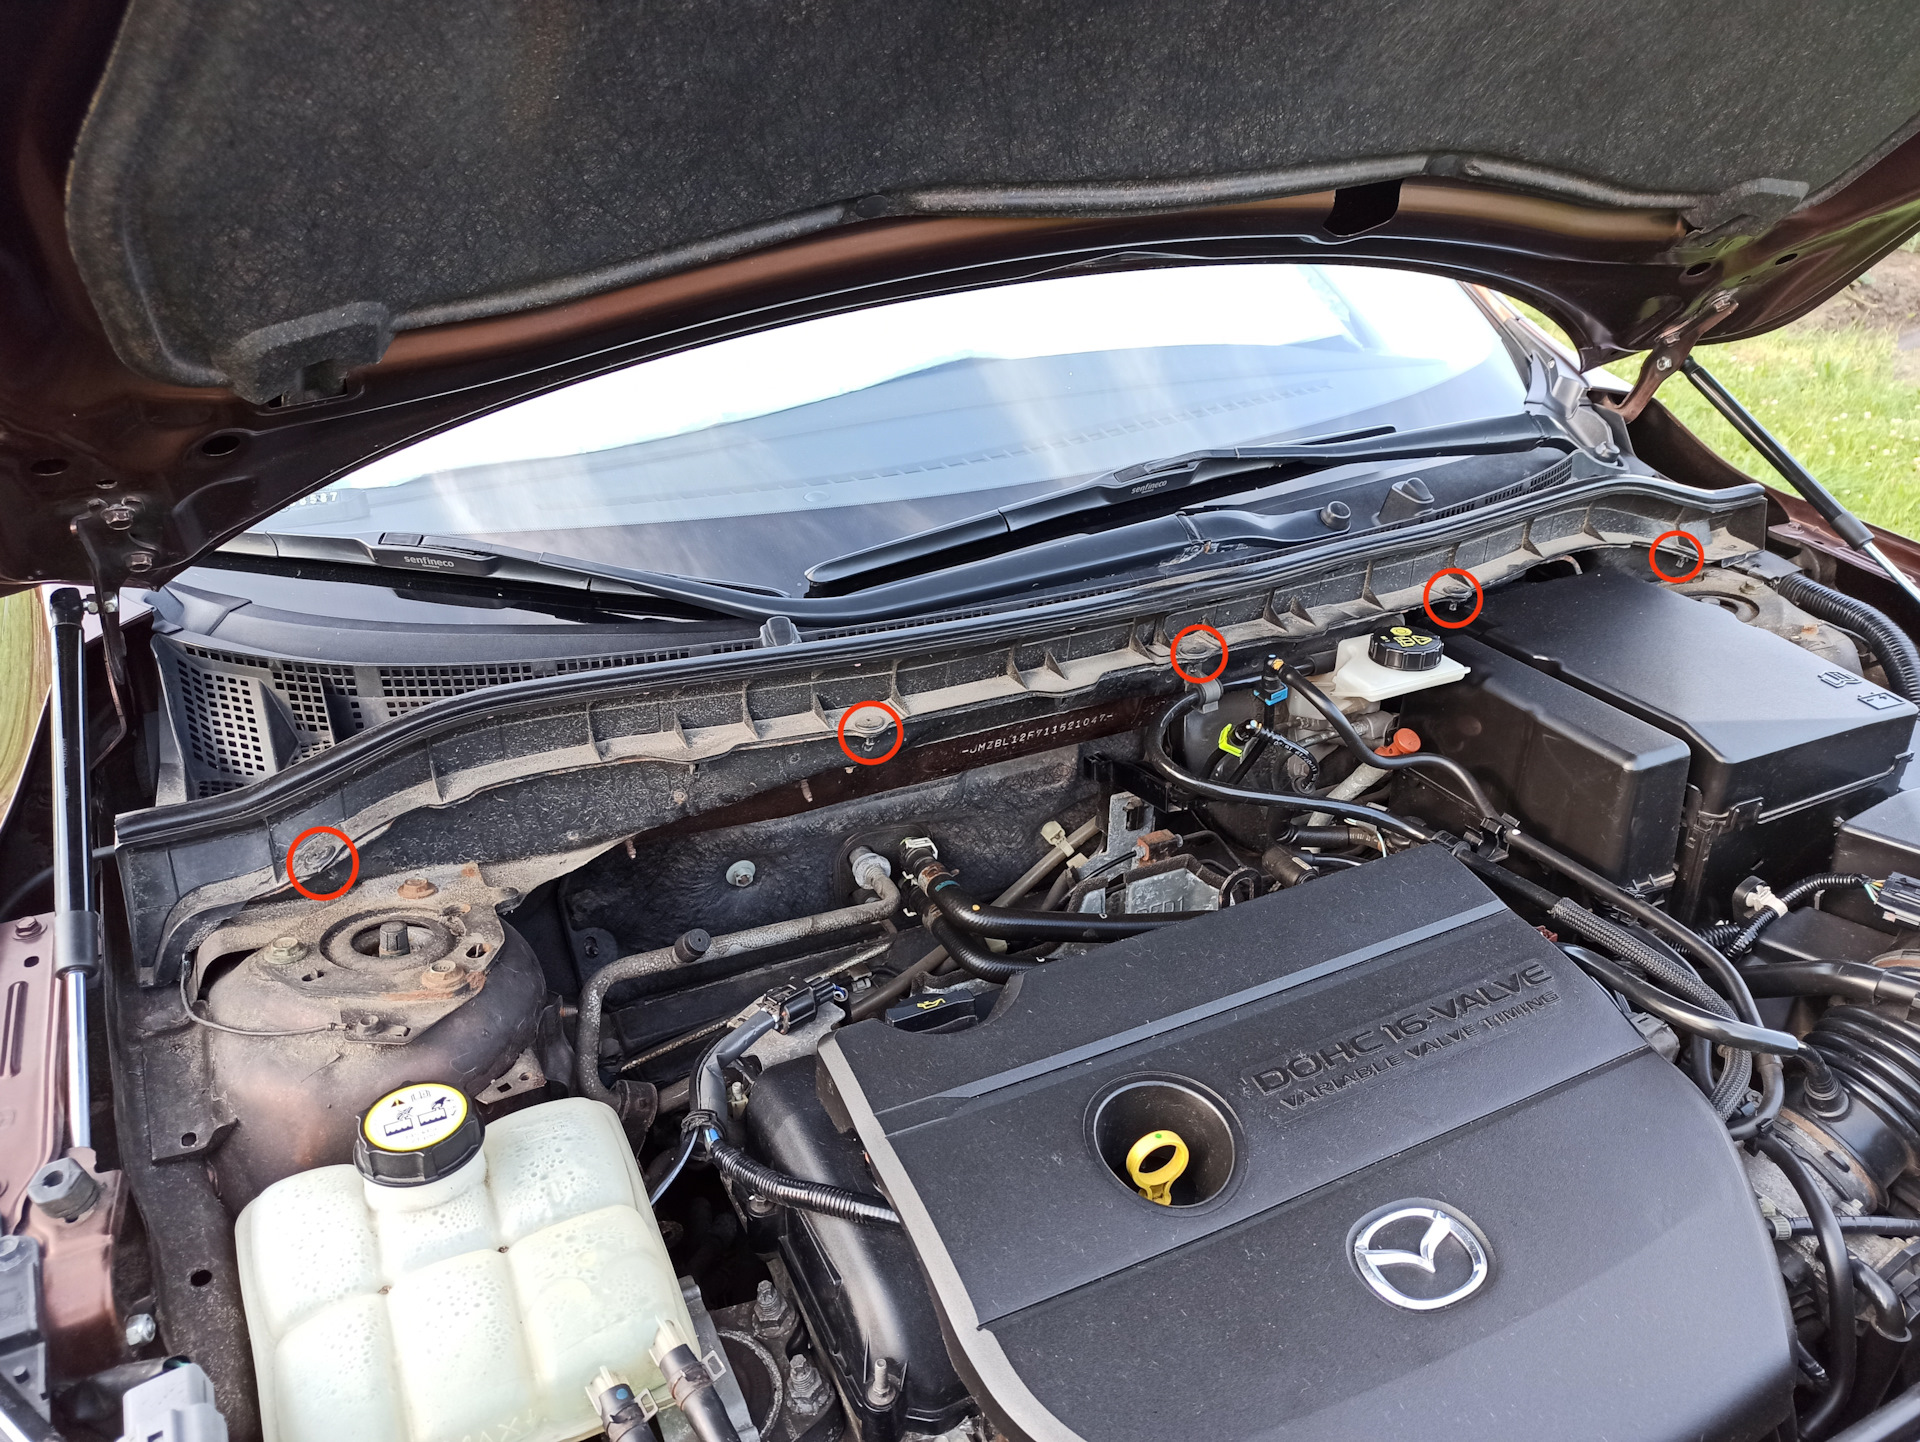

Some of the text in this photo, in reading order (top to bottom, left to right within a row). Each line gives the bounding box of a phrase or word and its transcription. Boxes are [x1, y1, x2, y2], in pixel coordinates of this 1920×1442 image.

[1131, 480, 1168, 494] senfineco
[403, 555, 455, 568] senfineco
[1250, 962, 1555, 1097] DOHC 16-VALVE
[1280, 989, 1563, 1111] VARIABLE VALVE TIMING
